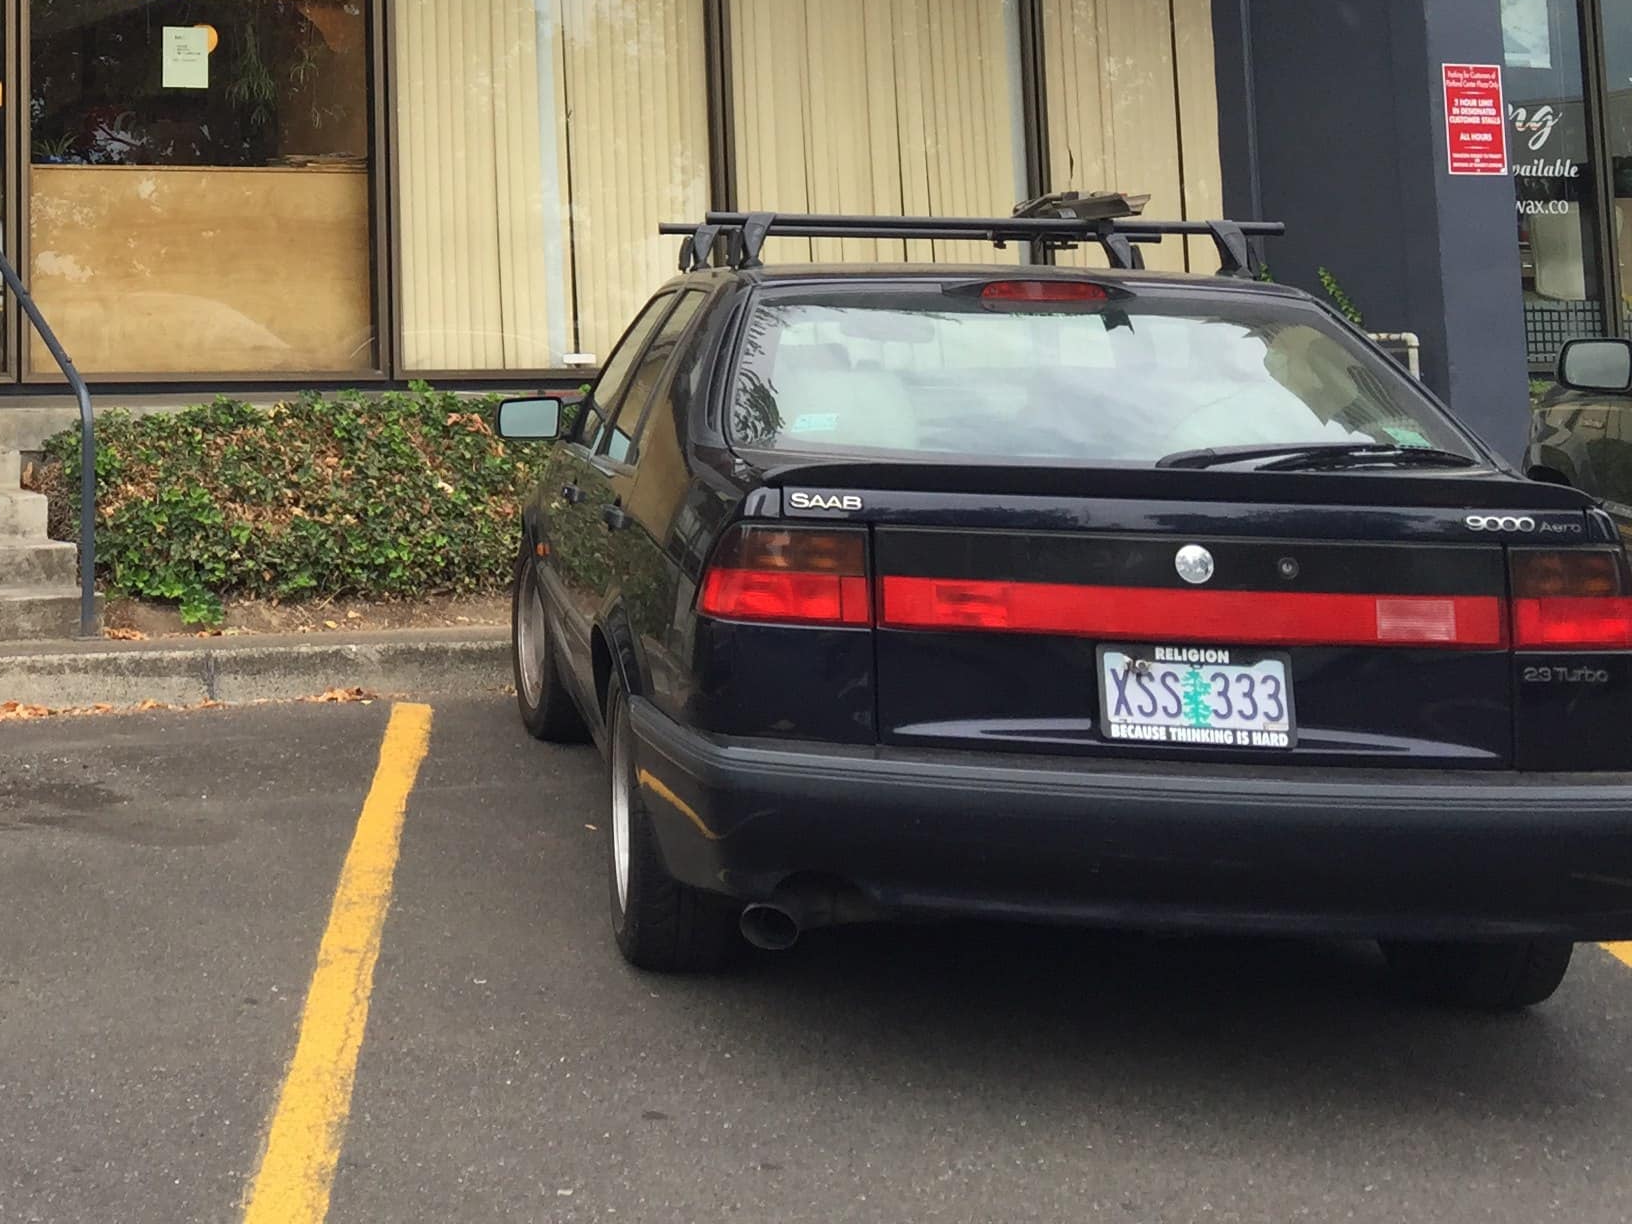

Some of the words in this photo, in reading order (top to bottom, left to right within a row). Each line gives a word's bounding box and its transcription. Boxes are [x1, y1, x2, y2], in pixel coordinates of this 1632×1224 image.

[790, 492, 863, 510] SAAB
[1466, 516, 1535, 532] 9000
[1539, 522, 1582, 533] Aero
[1154, 647, 1230, 664] RELIGION
[1553, 666, 1609, 683] Turbo
[1210, 672, 1285, 722] 333
[1111, 724, 1166, 740] BECAUSE
[1170, 727, 1233, 745] THINKING
[1237, 731, 1249, 745] IS
[1252, 732, 1289, 747] HARD
